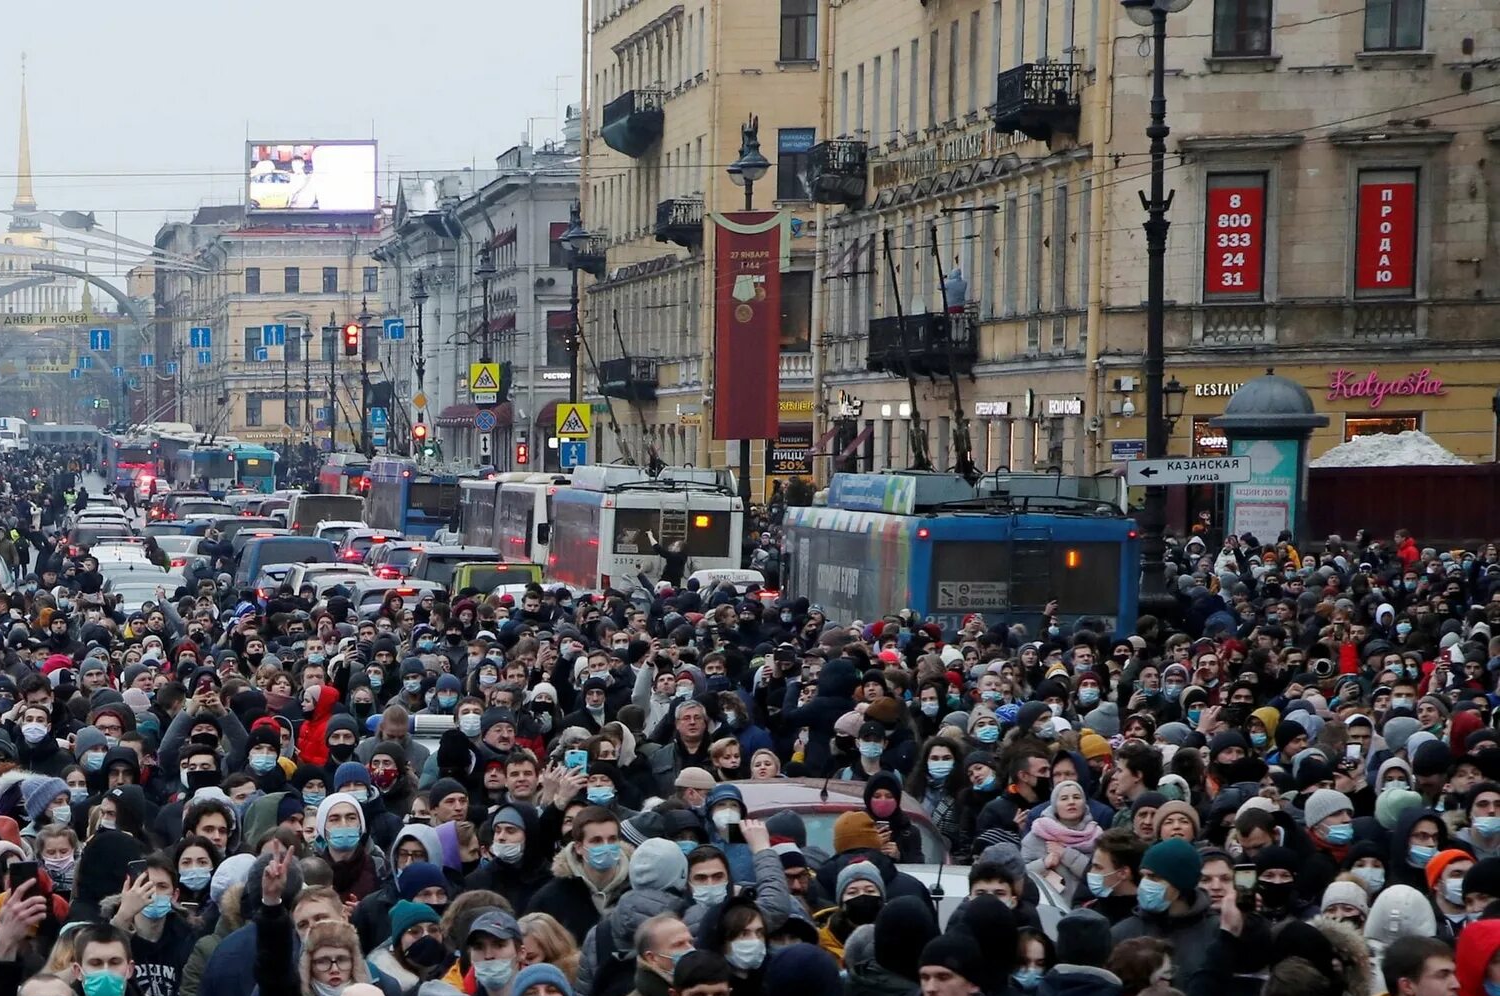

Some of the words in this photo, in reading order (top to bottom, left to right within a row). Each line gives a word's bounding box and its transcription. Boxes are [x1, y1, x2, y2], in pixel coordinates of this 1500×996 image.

[1229, 194, 1242, 209] 8
[1217, 213, 1251, 228] 800
[1217, 233, 1251, 248] 333
[1375, 188, 1393, 283] ПРОДАЮ
[1221, 252, 1245, 267] 24
[1221, 272, 1244, 286] 31
[3, 313, 34, 325] ДНЕЙ
[39, 316, 47, 324] И
[51, 312, 89, 324] НОЧЕЙ
[543, 372, 572, 380] РЕСТОР
[1195, 383, 1244, 396] RESTAU
[772, 451, 805, 461] ПИЦЦ
[774, 460, 805, 470] -50%
[1167, 459, 1239, 471] КАЗАНСКАЯ
[1186, 473, 1220, 484] улица
